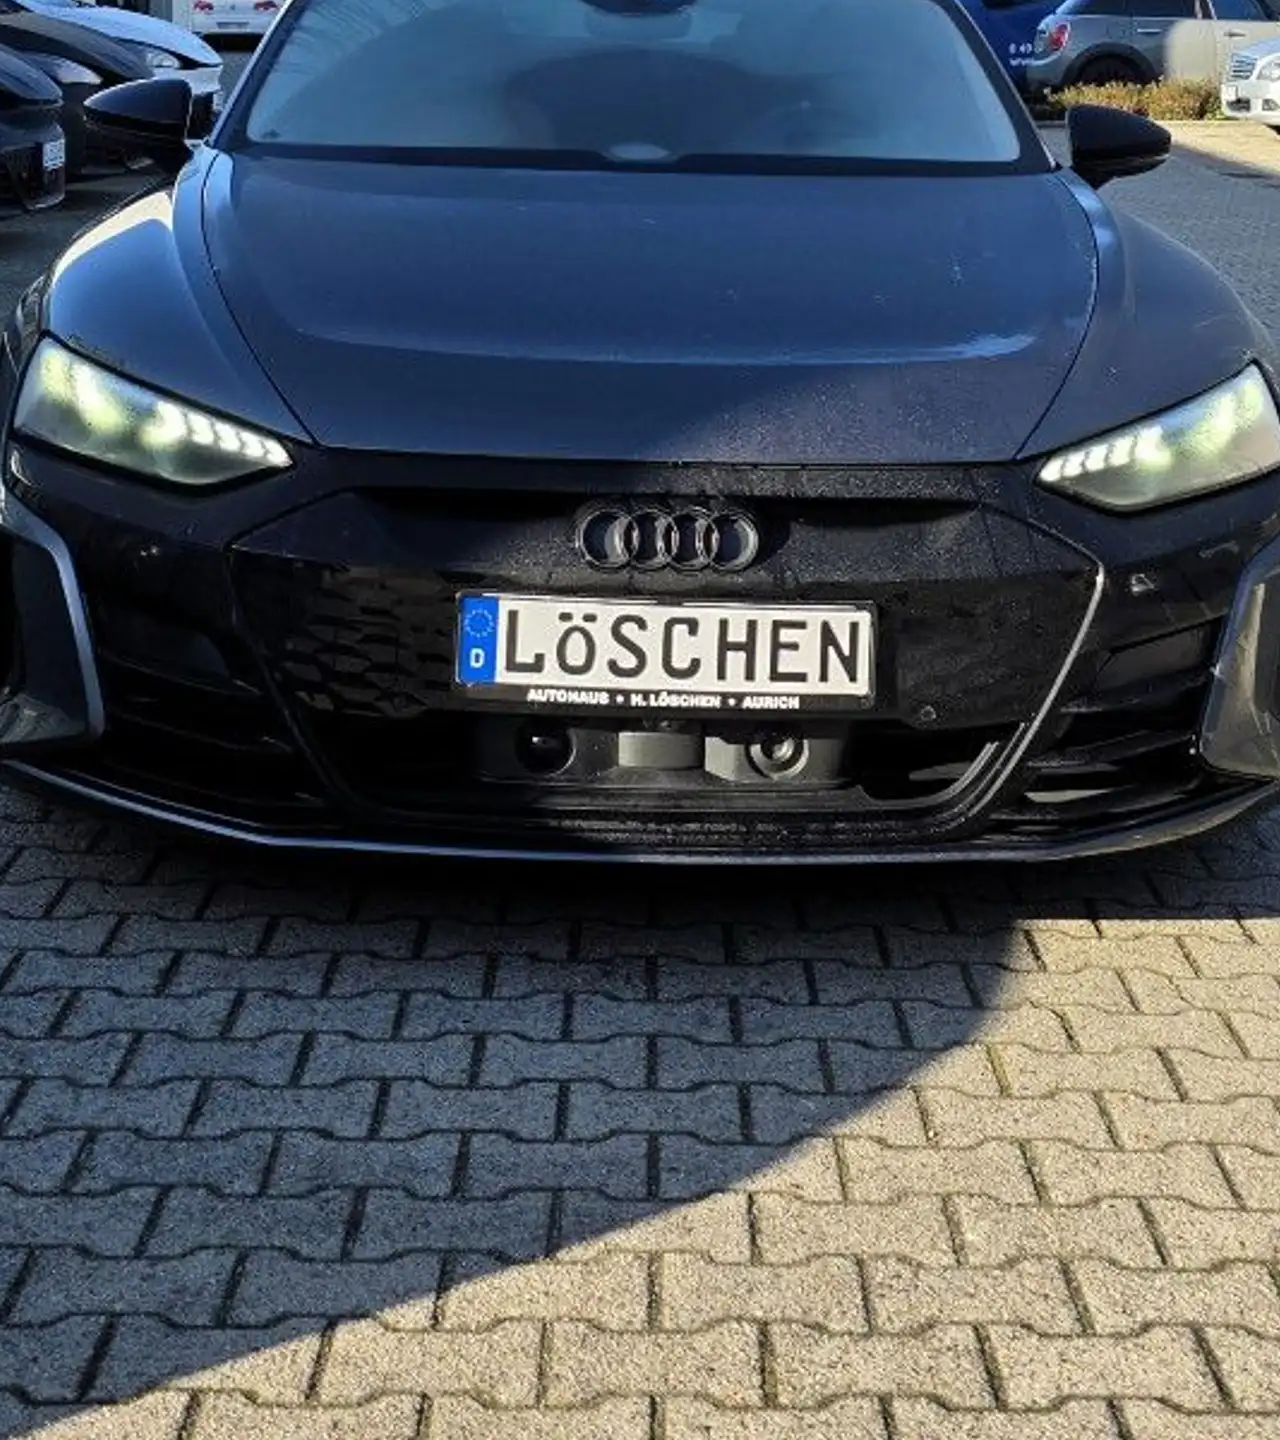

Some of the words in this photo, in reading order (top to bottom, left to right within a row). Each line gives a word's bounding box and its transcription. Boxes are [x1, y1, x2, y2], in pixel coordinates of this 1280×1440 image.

[504, 609, 861, 683] LÖSCHEN
[469, 648, 484, 668] D
[527, 688, 610, 705] AUTOHAUS
[631, 693, 648, 707] H.
[650, 691, 722, 708] LÖSCHEN
[742, 695, 800, 709] AURICH
